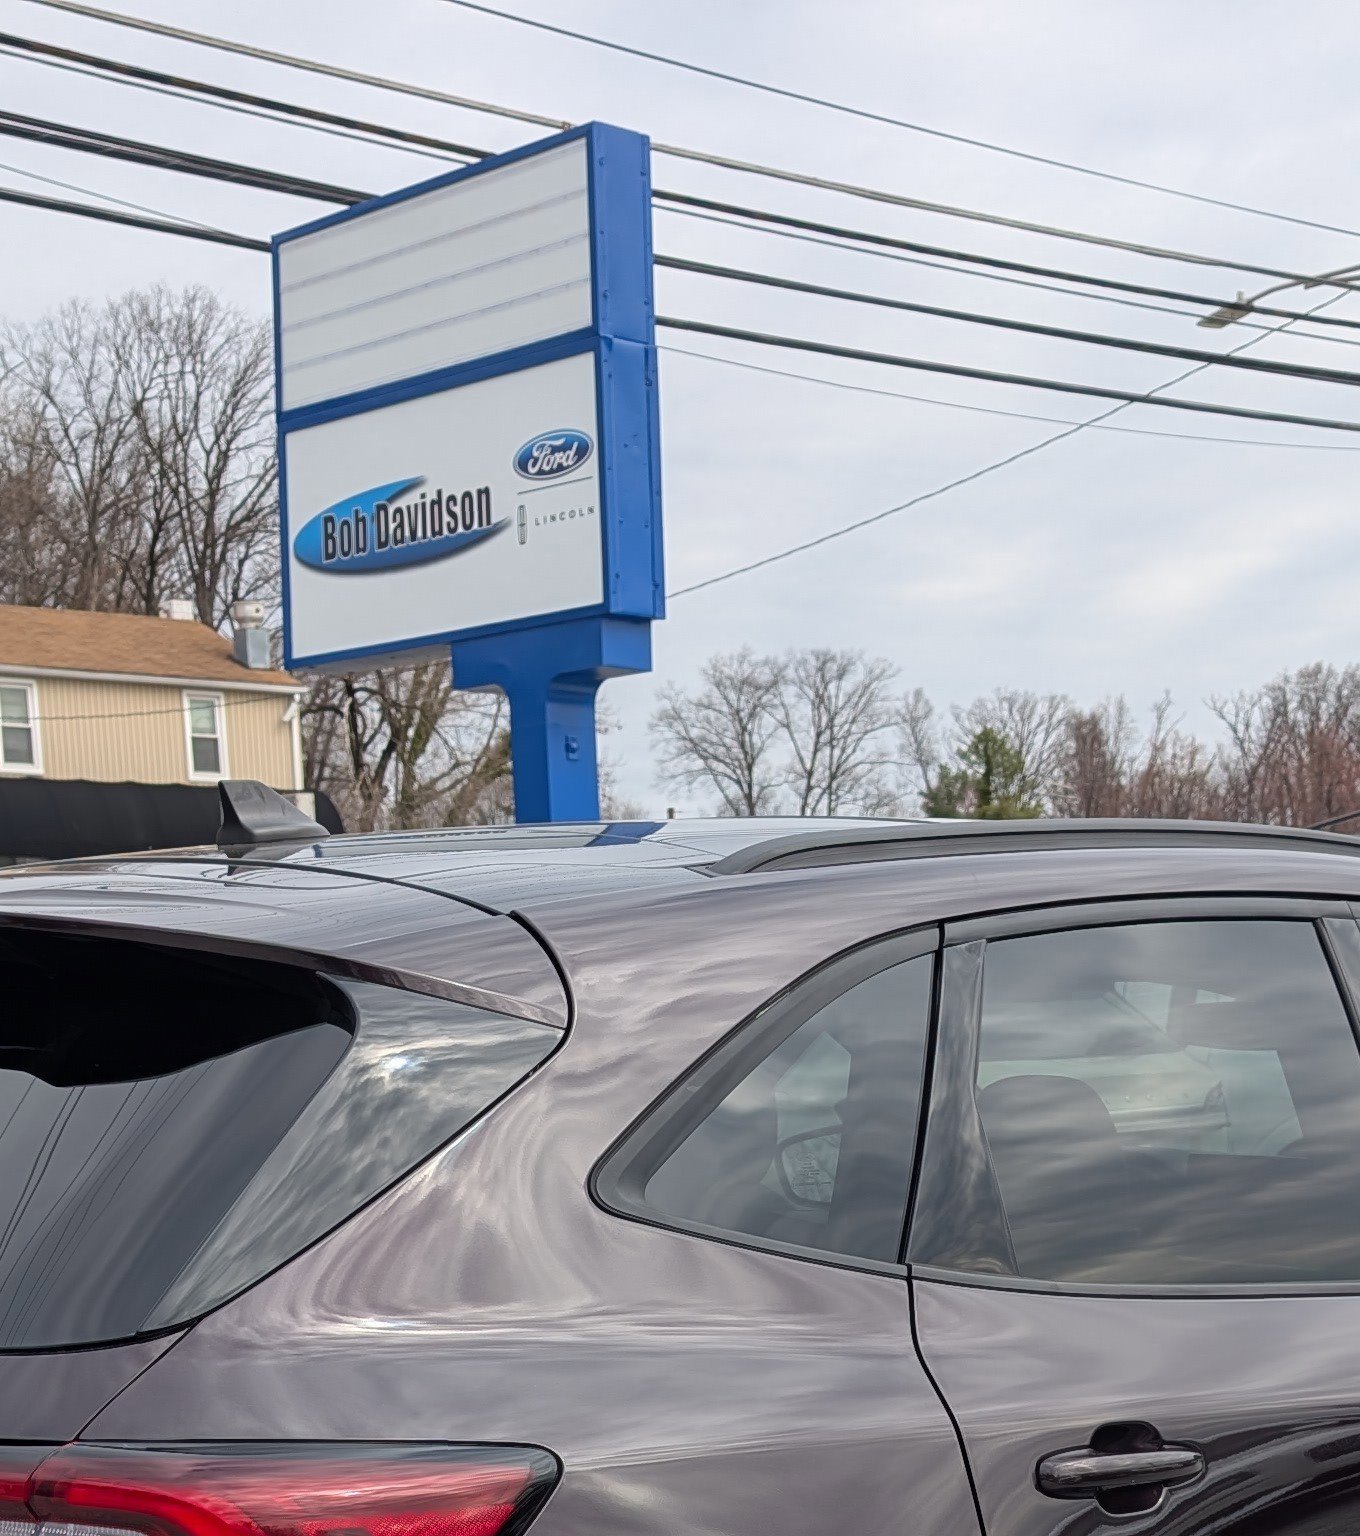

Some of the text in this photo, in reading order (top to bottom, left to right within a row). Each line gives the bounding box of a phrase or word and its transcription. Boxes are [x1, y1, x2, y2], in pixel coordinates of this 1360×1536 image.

[526, 435, 579, 475] Ford
[322, 485, 492, 562] Bob Davidson
[534, 505, 596, 526] LINCOLN
